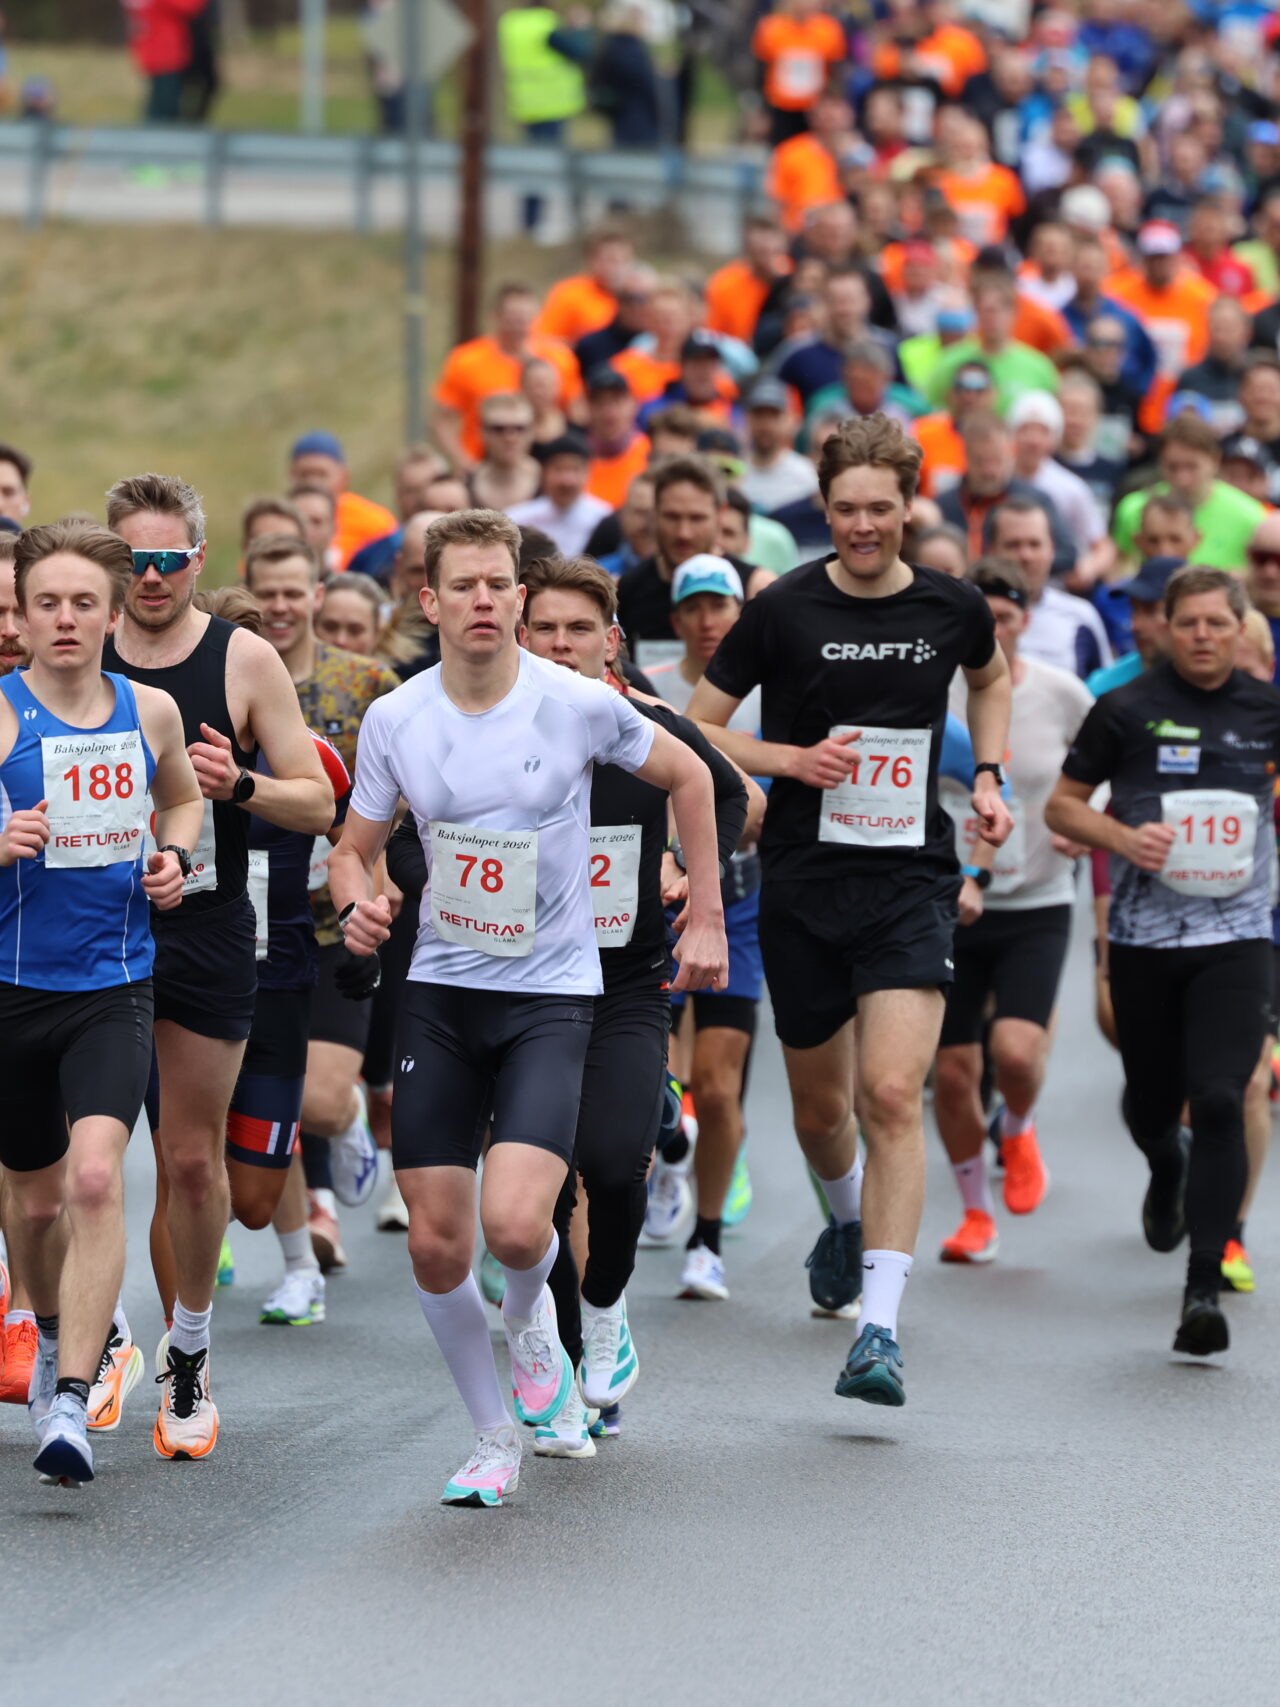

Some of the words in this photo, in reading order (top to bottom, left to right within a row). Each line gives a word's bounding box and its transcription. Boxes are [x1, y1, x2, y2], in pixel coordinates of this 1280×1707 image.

[821, 642, 913, 661] CRAFT
[63, 762, 134, 801] 188
[829, 812, 907, 829] RETURA
[1179, 814, 1241, 846] 119
[55, 831, 131, 848] RETURA
[437, 829, 500, 848] Baksjøløpet
[502, 840, 531, 850] 2026
[455, 853, 504, 893] 78
[439, 909, 515, 936] RETURA
